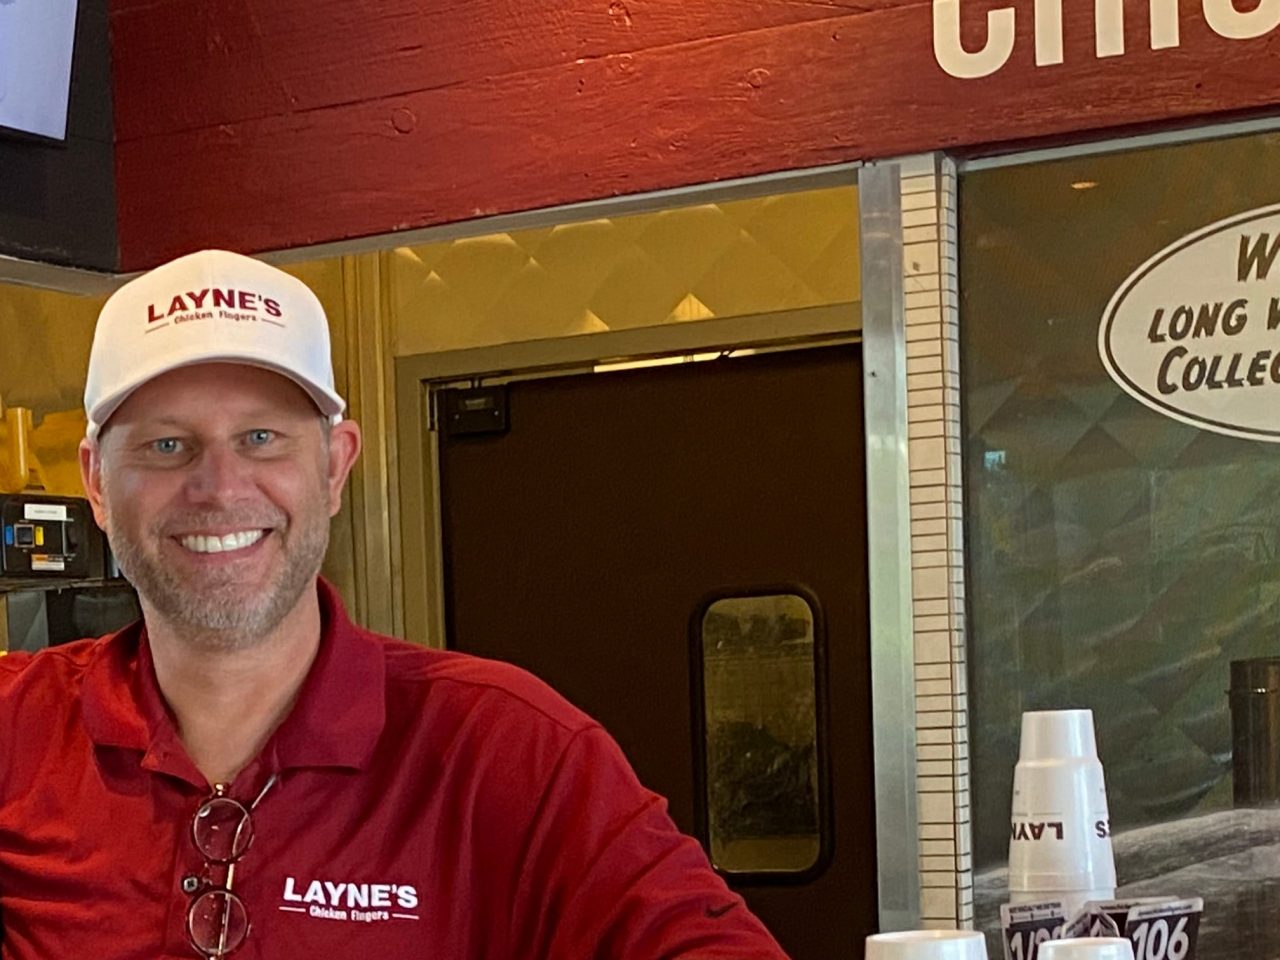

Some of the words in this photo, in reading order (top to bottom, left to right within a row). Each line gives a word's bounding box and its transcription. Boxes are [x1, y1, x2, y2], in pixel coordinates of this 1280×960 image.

[147, 288, 282, 324] LAYNE'S
[174, 311, 213, 325] Chicken
[219, 310, 257, 322] Fingers
[1147, 298, 1249, 343] LONG
[282, 876, 419, 909] LAYNE'S
[309, 905, 347, 920] Chicken
